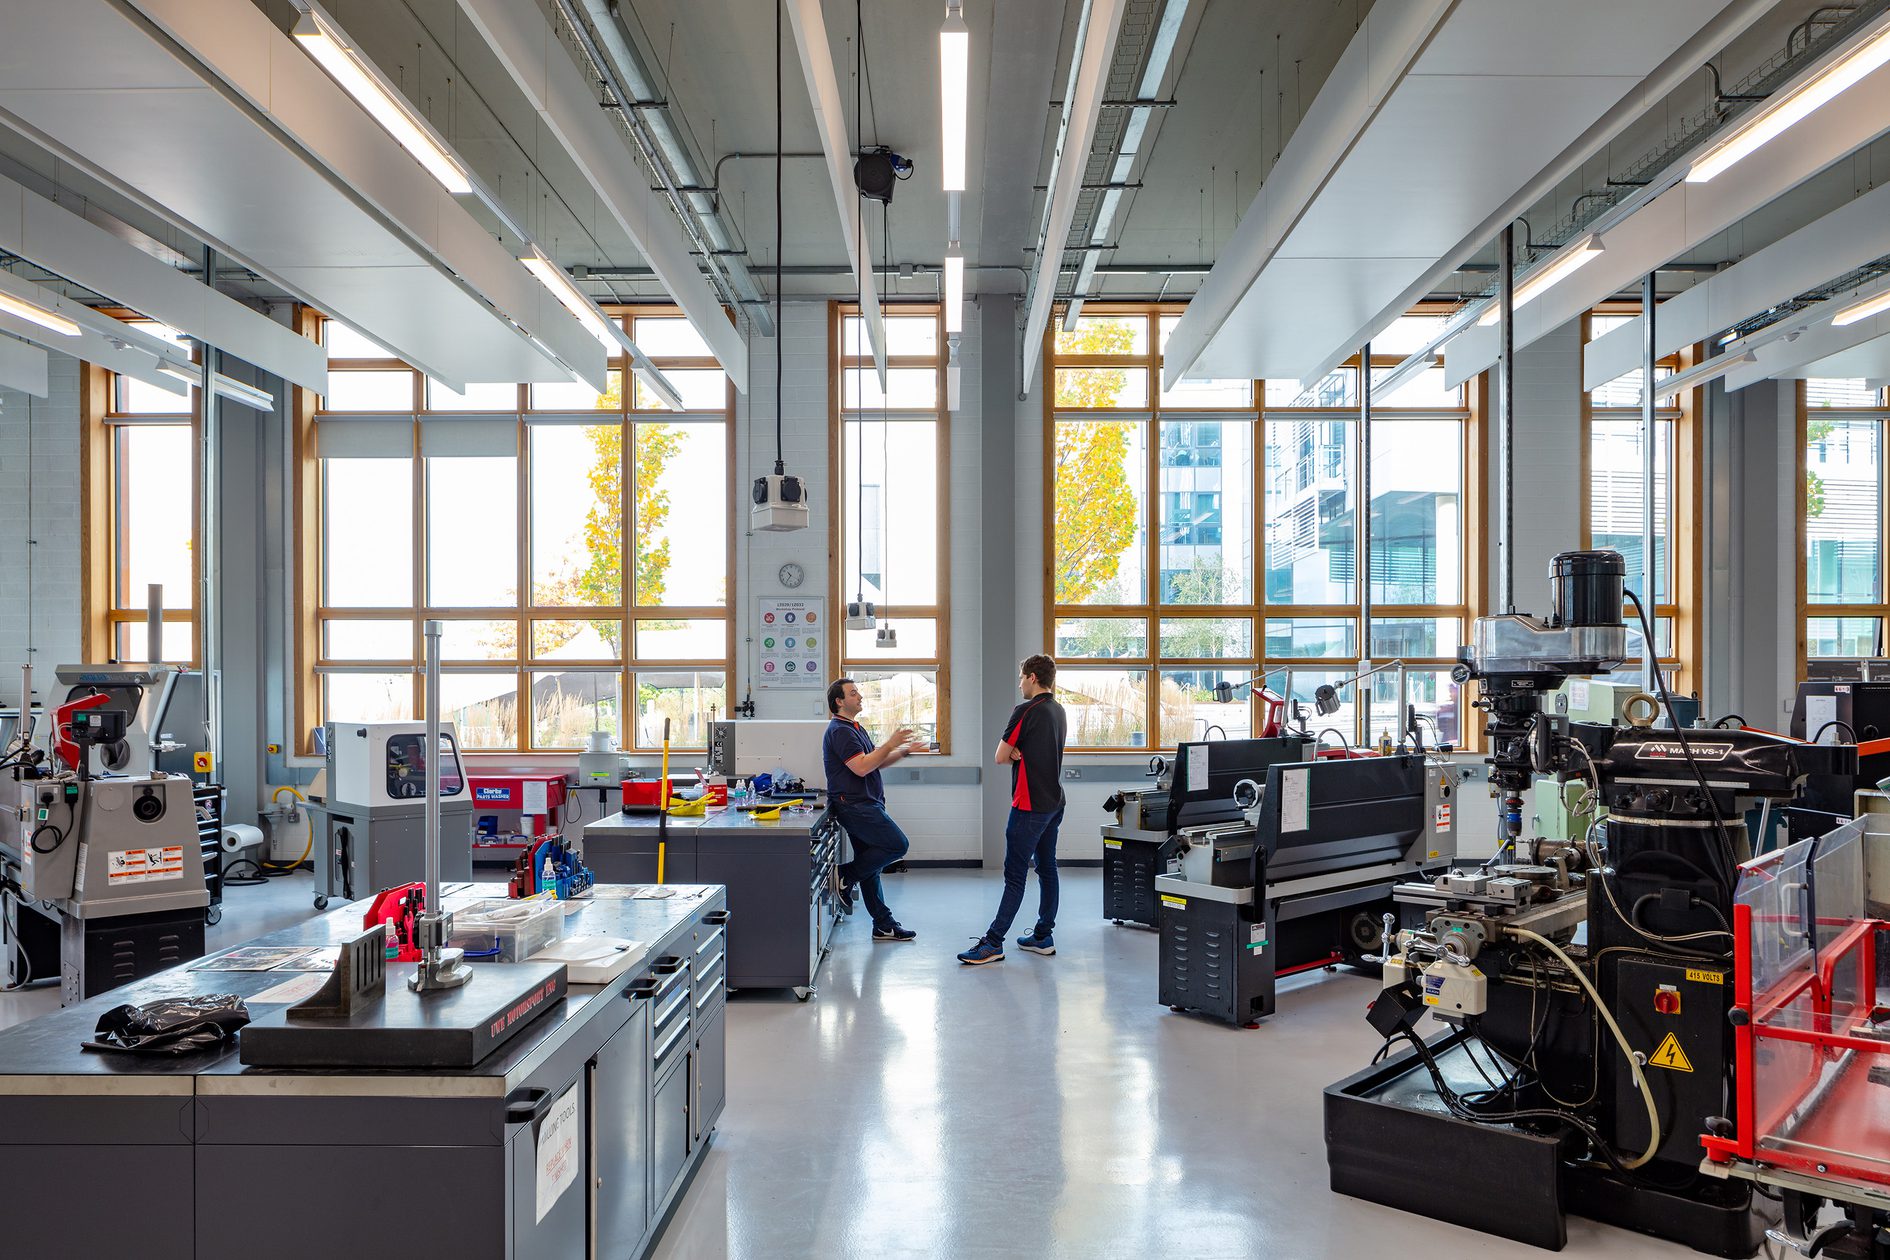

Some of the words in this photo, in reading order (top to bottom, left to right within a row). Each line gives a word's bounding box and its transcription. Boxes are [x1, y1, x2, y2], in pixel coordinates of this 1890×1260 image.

[1702, 973, 1720, 982] VOLTS
[490, 1016, 505, 1039] UWE
[507, 986, 545, 1027] MOTORSPORT
